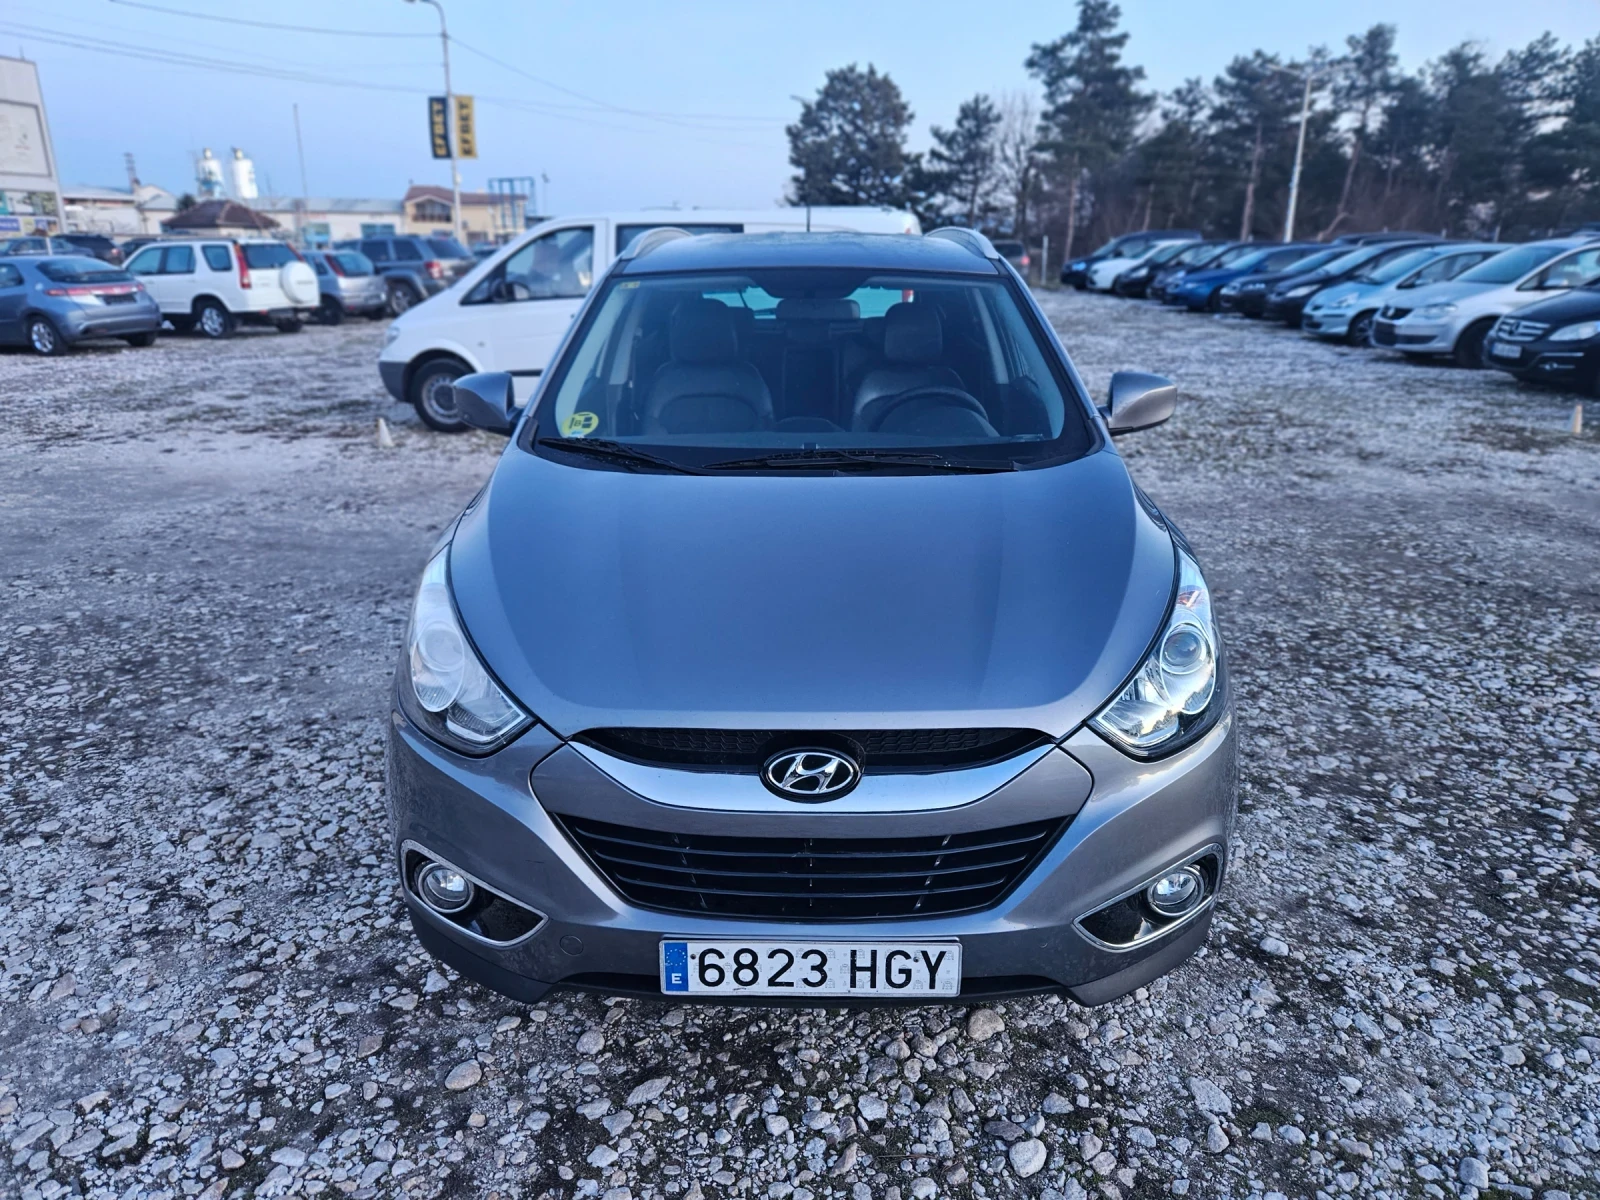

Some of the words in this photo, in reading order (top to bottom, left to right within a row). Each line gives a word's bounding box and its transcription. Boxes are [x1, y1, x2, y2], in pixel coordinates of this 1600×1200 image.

[671, 973, 682, 984] E
[698, 947, 828, 988] 6823
[849, 949, 947, 990] HGY
